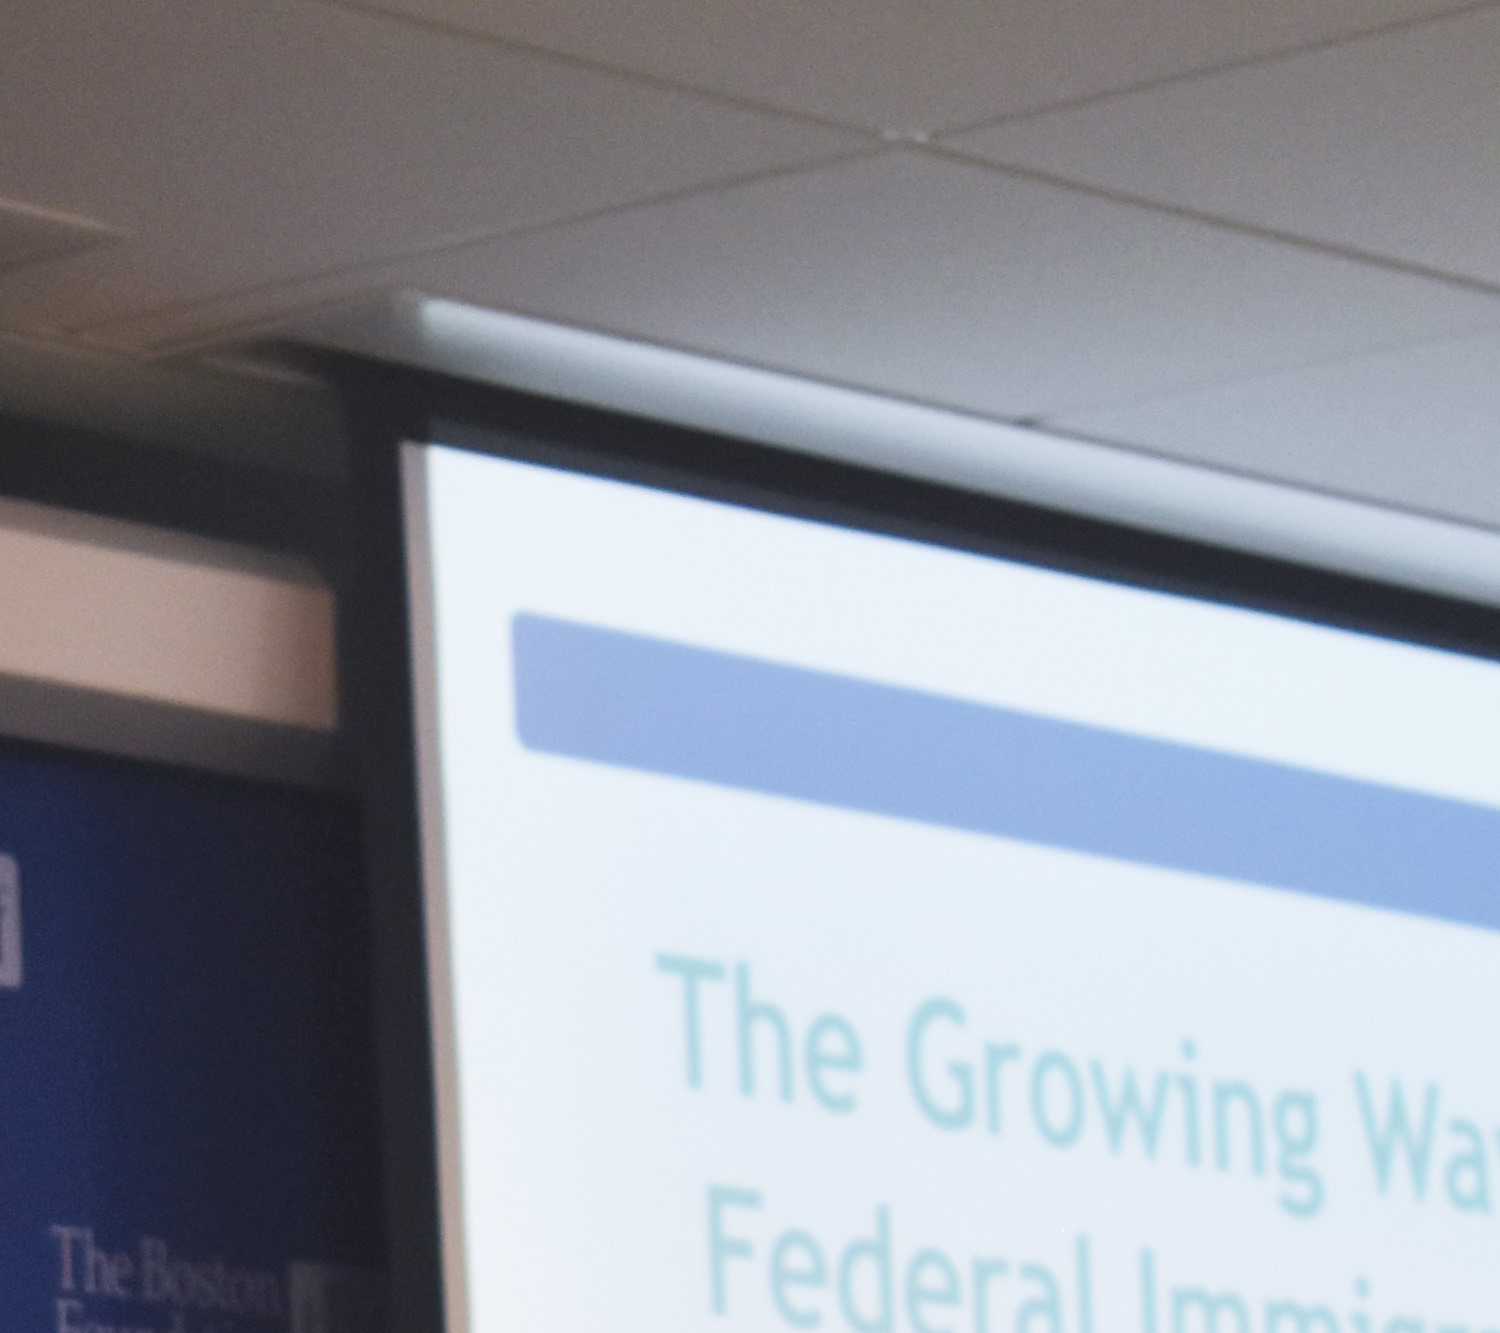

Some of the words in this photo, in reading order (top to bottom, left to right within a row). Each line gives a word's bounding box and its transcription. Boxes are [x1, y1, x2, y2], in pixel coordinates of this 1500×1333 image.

[654, 951, 862, 1116] The
[905, 996, 1325, 1221] Growing
[48, 1222, 132, 1297] The
